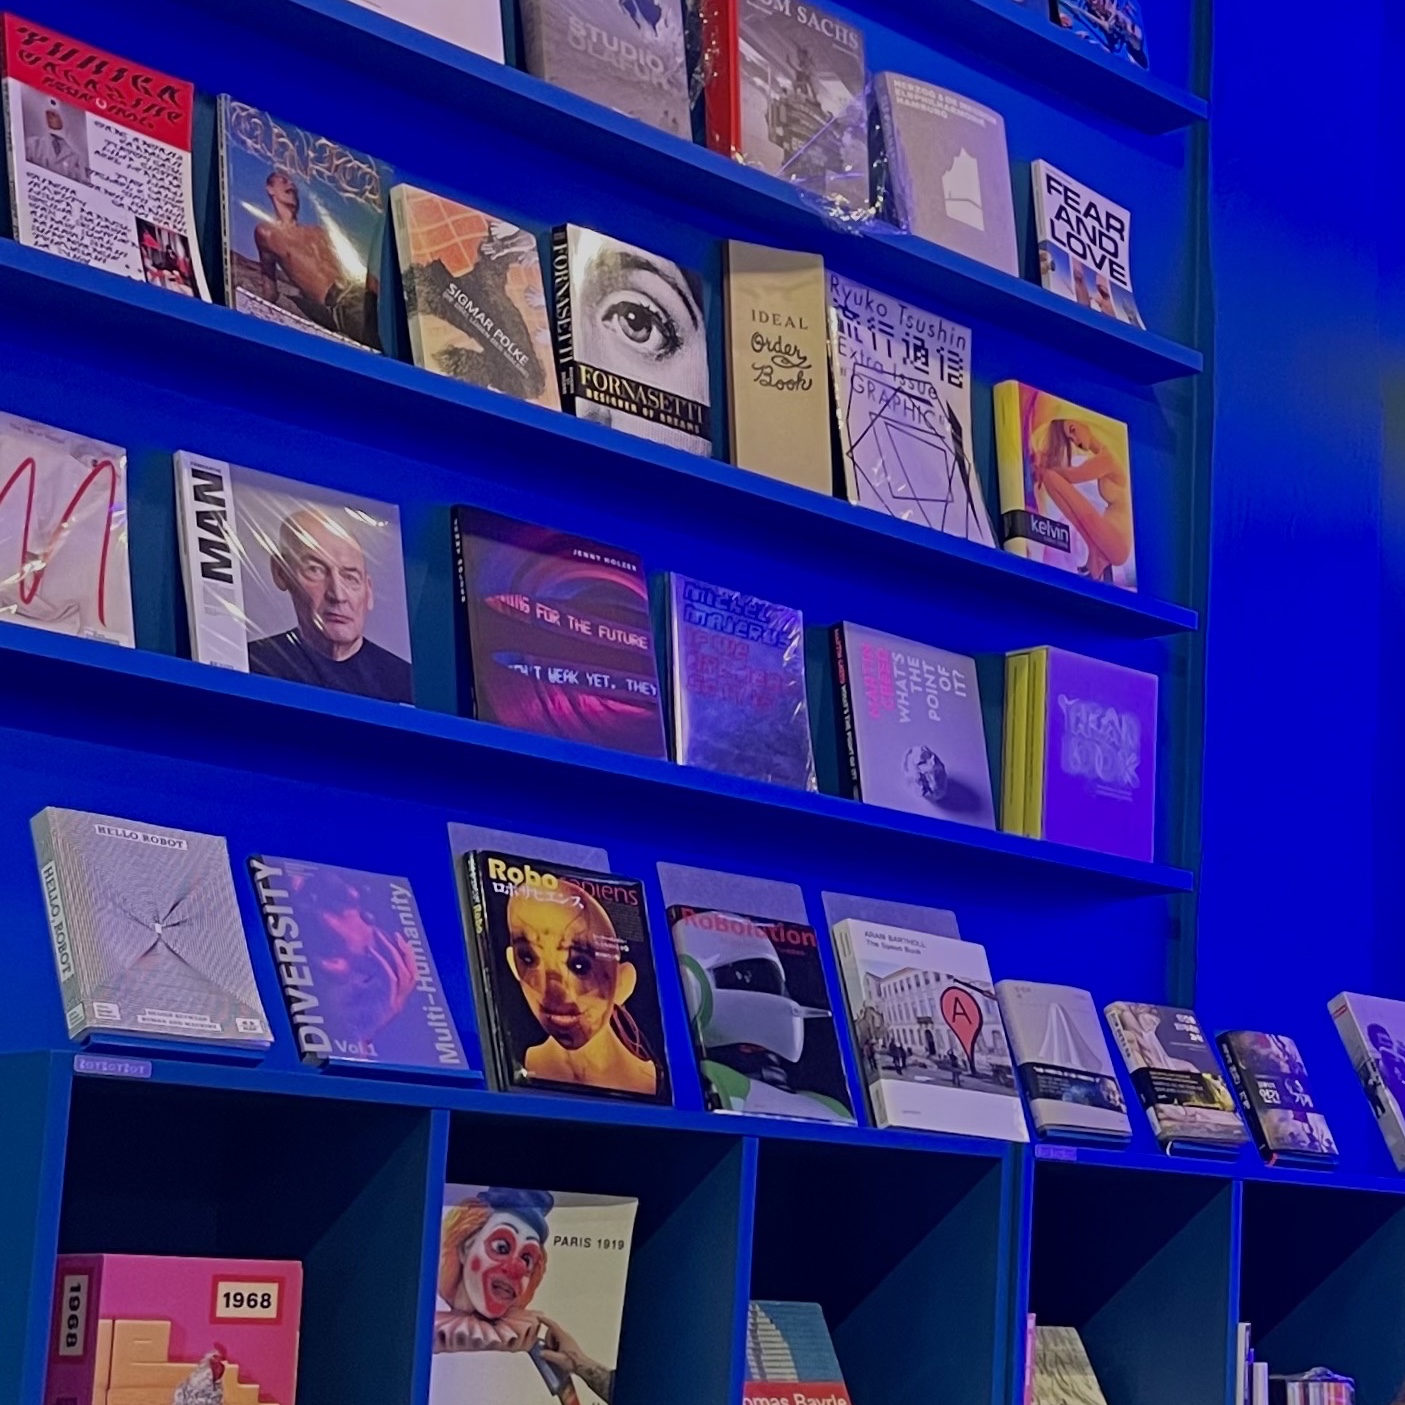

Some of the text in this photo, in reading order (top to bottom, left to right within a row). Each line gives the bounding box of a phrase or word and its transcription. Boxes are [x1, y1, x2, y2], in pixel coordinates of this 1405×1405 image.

[567, 15, 664, 72] STUDIO
[797, 8, 859, 49] SACHS
[1045, 174, 1125, 242] FEAR
[1051, 218, 1127, 285] LOVE
[1054, 206, 1119, 259] AND
[448, 283, 530, 367] SIGMAR POLKE
[552, 244, 575, 366] FORNASETTI
[751, 309, 809, 330] IDEAL
[830, 275, 967, 351] Ryuko Tsushin
[751, 331, 810, 365] Order
[838, 339, 937, 400] Extra Issue
[578, 364, 704, 424] FORNASETTI
[752, 361, 813, 391] Book
[585, 388, 700, 434] DESIGNER OF DREAMS
[190, 467, 234, 584] MAN
[1031, 516, 1069, 542] kelvin
[572, 548, 637, 572] JENNY HOLZER
[567, 615, 592, 636] THE
[599, 624, 649, 650] FUTURE
[626, 678, 658, 696] THEY
[907, 655, 923, 694] THE
[923, 659, 941, 722] POINT
[937, 664, 951, 692] OF
[952, 668, 967, 698] IT?
[96, 824, 186, 851] HELLO ROBOT
[487, 857, 559, 891] Robo
[54, 923, 72, 975] ROBOT
[250, 858, 333, 1054] DIVERSITY
[389, 882, 460, 1065] Multi-Humanity
[952, 996, 972, 1025] A
[553, 1235, 625, 1251] PARIS 1919
[65, 1282, 82, 1348] 1968
[223, 1291, 272, 1309] 1968
